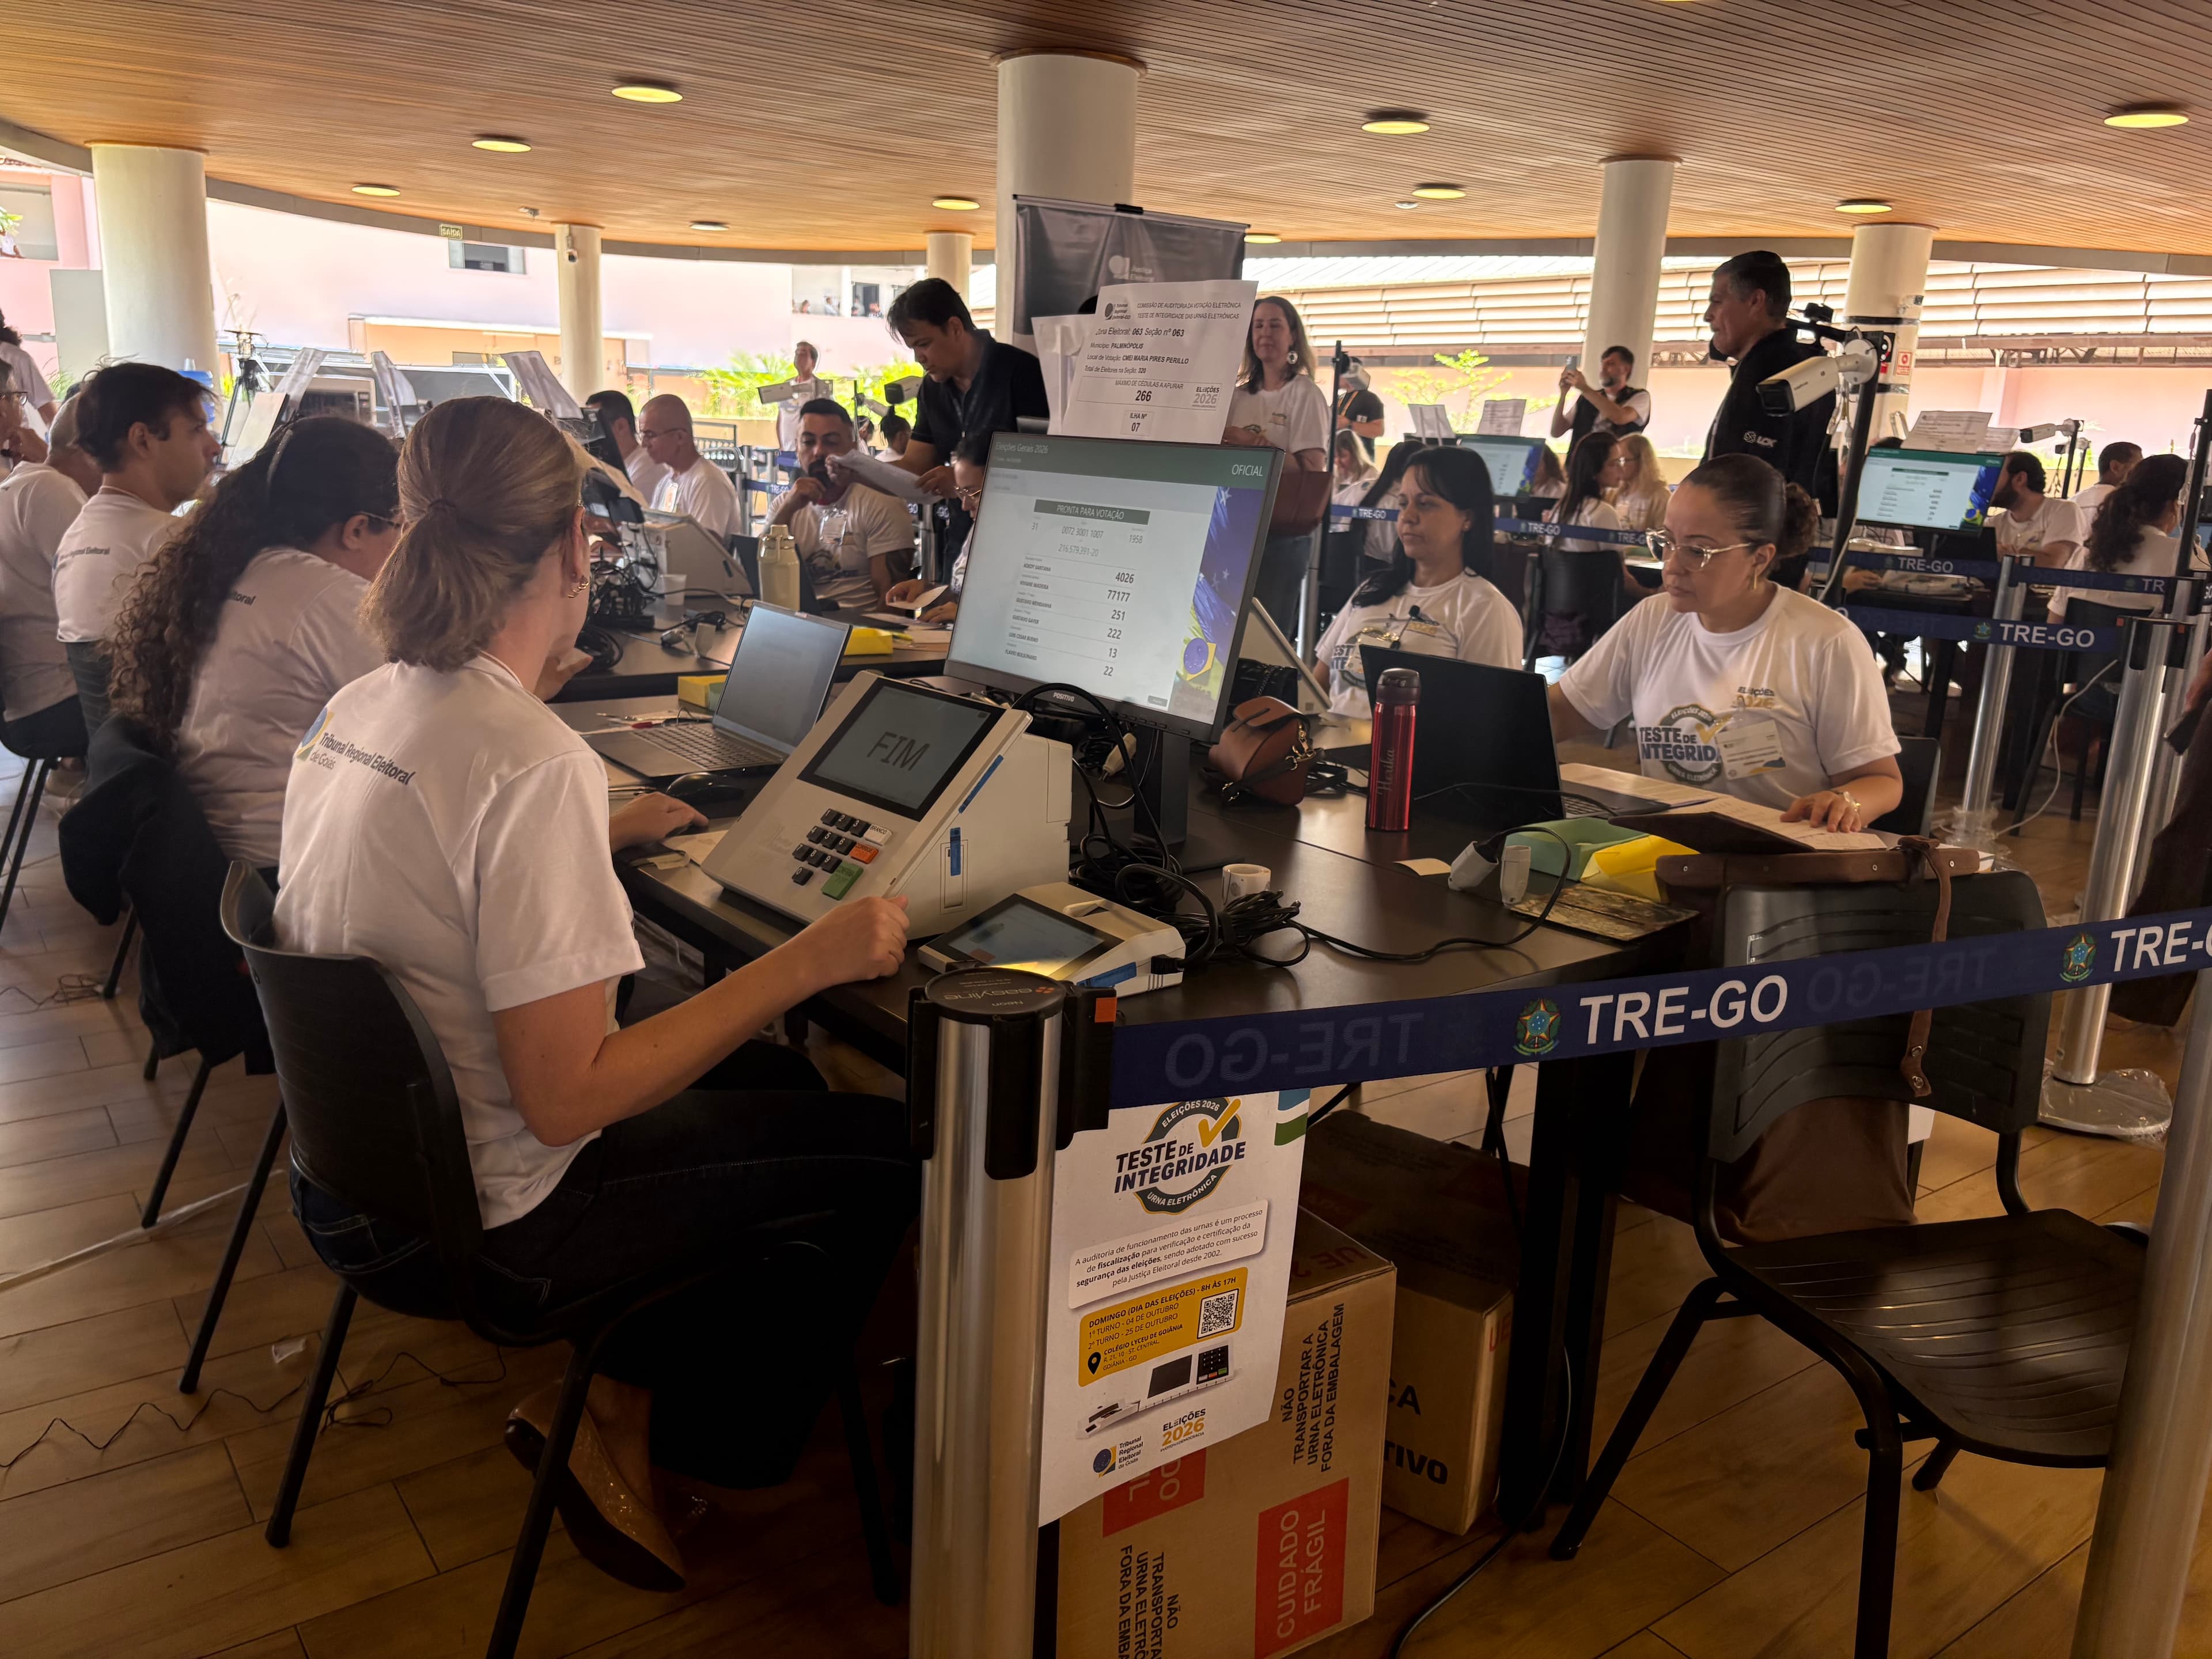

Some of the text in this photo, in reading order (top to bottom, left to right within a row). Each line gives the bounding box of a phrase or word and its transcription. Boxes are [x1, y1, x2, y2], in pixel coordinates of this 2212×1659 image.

[1145, 328, 1162, 336] Seção
[1135, 391, 1152, 402] 266
[1194, 393, 1218, 404] 2026
[1131, 423, 1141, 433] 07
[996, 442, 1048, 453] Eleições Gerais 2026
[1232, 464, 1263, 478] OFICIAL
[1057, 504, 1124, 521] PRONTA PARA VOTAÇÃO
[1358, 508, 1386, 520] TRE-GO
[1062, 527, 1074, 535] 0072
[1075, 528, 1088, 537] 3001
[1090, 529, 1103, 539] 1007
[1130, 535, 1143, 544] 1958
[1528, 522, 1560, 535] TRE-GO
[1618, 532, 1645, 544] TRE-G
[1115, 572, 1134, 584] 4026
[1898, 556, 1953, 574] TRE-GO
[1107, 589, 1131, 602] 77177
[1111, 609, 1126, 621] 251
[1108, 628, 1122, 639] 222
[1999, 622, 2096, 649] TRE-GO
[1109, 647, 1118, 658] 13
[1104, 666, 1113, 676] 22
[1053, 692, 1075, 702] POSITIVO
[1640, 726, 1696, 743] TESTE DE
[319, 732, 416, 785] Tribunal Regional Eleitoral
[866, 731, 930, 772] FIM
[1642, 744, 1722, 761] NTEGRID
[870, 825, 887, 834] BRANCO
[2110, 920, 2212, 972] TRE-
[944, 988, 1032, 999] easyline
[1578, 973, 1789, 1046] TRE-GO
[1162, 1100, 1220, 1127] ELEIÇÕES 2026
[1115, 1141, 1246, 1194] INTEGRIDADE
[1116, 1140, 1194, 1173] TESTE DE
[1147, 1175, 1217, 1206] URNA ELETRÔNICA
[1082, 1249, 1114, 1263] auditoria
[1127, 1230, 1178, 1250] funcionamento
[1194, 1222, 1213, 1231] urnas
[1234, 1210, 1262, 1223] processo
[1098, 1252, 1140, 1270] fiscalização
[1142, 1247, 1157, 1257] para
[1160, 1235, 1195, 1251] verificação
[1203, 1224, 1240, 1239] certificação
[1077, 1271, 1115, 1287] segurança
[1117, 1266, 1129, 1274] das
[1131, 1256, 1162, 1270] eleições,
[1164, 1249, 1185, 1260] sendo
[1186, 1242, 1214, 1253] adotado
[1232, 1231, 1257, 1242] sucesso
[1112, 1249, 1222, 1287] pela Justiça Eleitoral desde 2002.
[1089, 1310, 1126, 1328] DOMINGO
[1128, 1305, 1143, 1316] (DIA
[1145, 1299, 1159, 1309] DAS
[1161, 1288, 1195, 1304] ELEIÇÕES)
[1212, 1281, 1221, 1289] ÀS
[1224, 1277, 1236, 1285] 17H
[1096, 1313, 1178, 1346] TURNO 25 DE OUTUBRO
[1097, 1322, 1120, 1335] TURNO
[1136, 1314, 1144, 1322] DE
[1146, 1303, 1179, 1318] OUTUBRO
[1104, 1342, 1130, 1355] COLÉGIO
[1131, 1335, 1148, 1346] LYCEU
[1158, 1324, 1183, 1336] GOIÂNIA
[1103, 1360, 1124, 1370] GOIÂNIA
[1293, 1333, 1313, 1464] TRANSPORTAR A
[1308, 1320, 1328, 1465] URNA ELETRÔNICA
[1321, 1303, 1344, 1472] FORA DA EMBALAGEM
[1281, 1387, 1294, 1422] NÃO
[1162, 1417, 1205, 1447] 2026
[1163, 1408, 1206, 1431] ELEIÇÕES
[1119, 1442, 1143, 1455] Regional
[1120, 1435, 1141, 1448] Tribunal
[1119, 1450, 1141, 1463] Eleitoral
[1384, 1443, 1448, 1484] TIVO
[1120, 1544, 1132, 1592] FORA
[1277, 1510, 1300, 1638] CUIDADO
[1304, 1510, 1325, 1615] FRÁGIL
[1119, 1592, 1131, 1618] DA
[1134, 1551, 1149, 1659] URNA ELETRÔ
[1151, 1552, 1164, 1659] TRANSPORTA
[1167, 1593, 1180, 1629] NÃO
